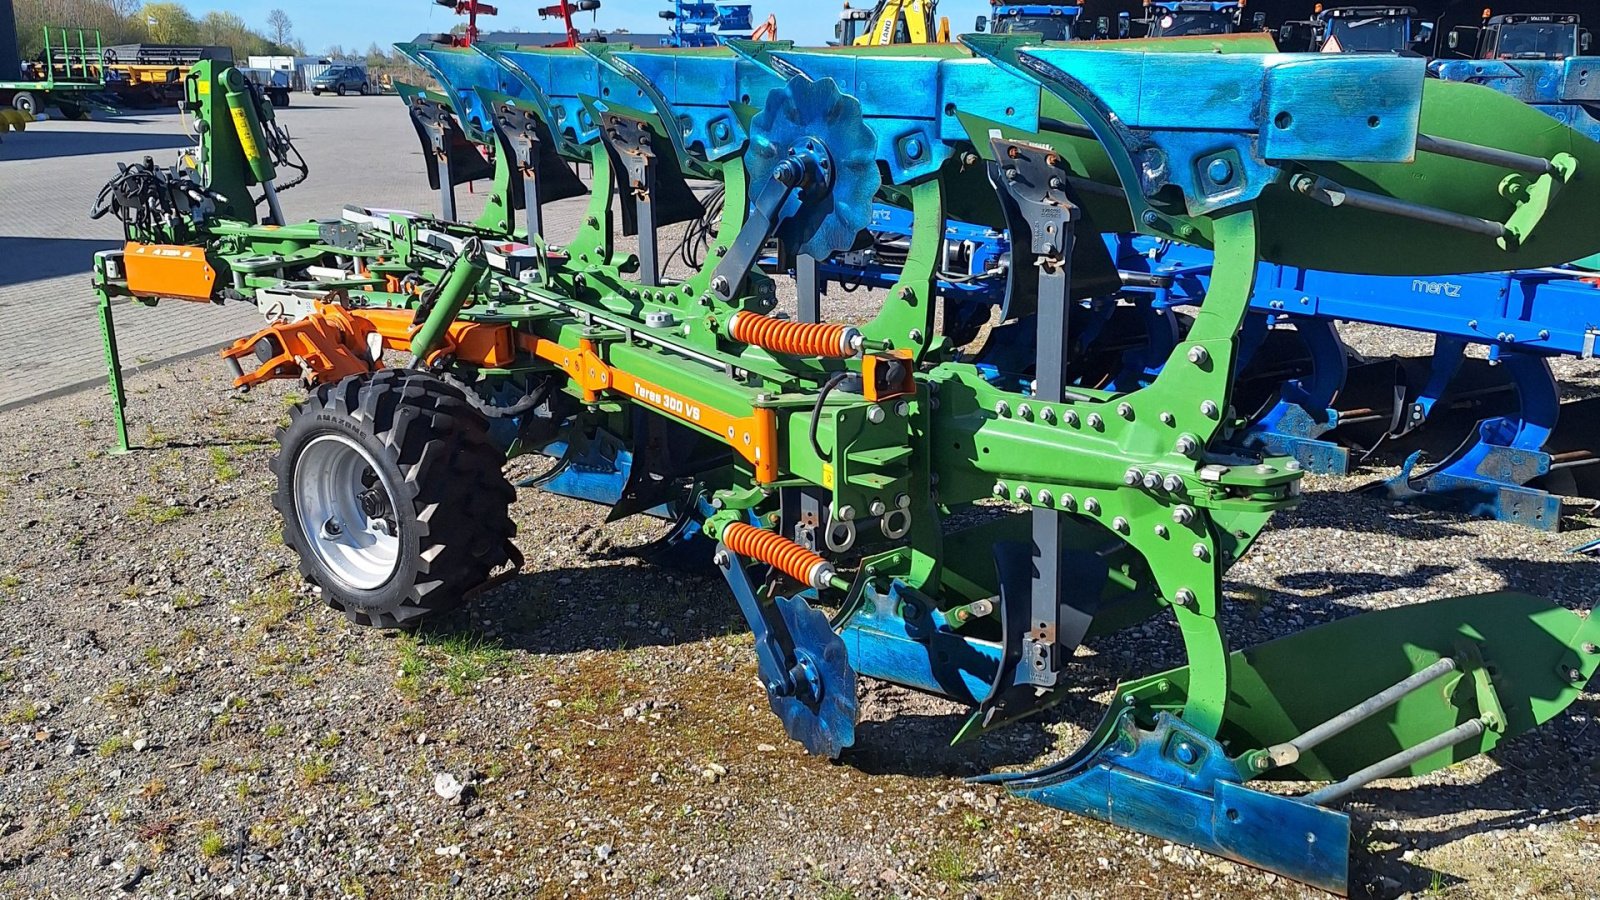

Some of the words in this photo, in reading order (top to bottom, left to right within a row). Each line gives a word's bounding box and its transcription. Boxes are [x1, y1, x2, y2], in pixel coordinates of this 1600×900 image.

[881, 20, 892, 45] LAND
[872, 208, 892, 221] ertz
[1412, 279, 1462, 298] mertz
[634, 382, 661, 404] Teres
[662, 394, 684, 414] 300
[317, 414, 367, 440] AMAZONE
